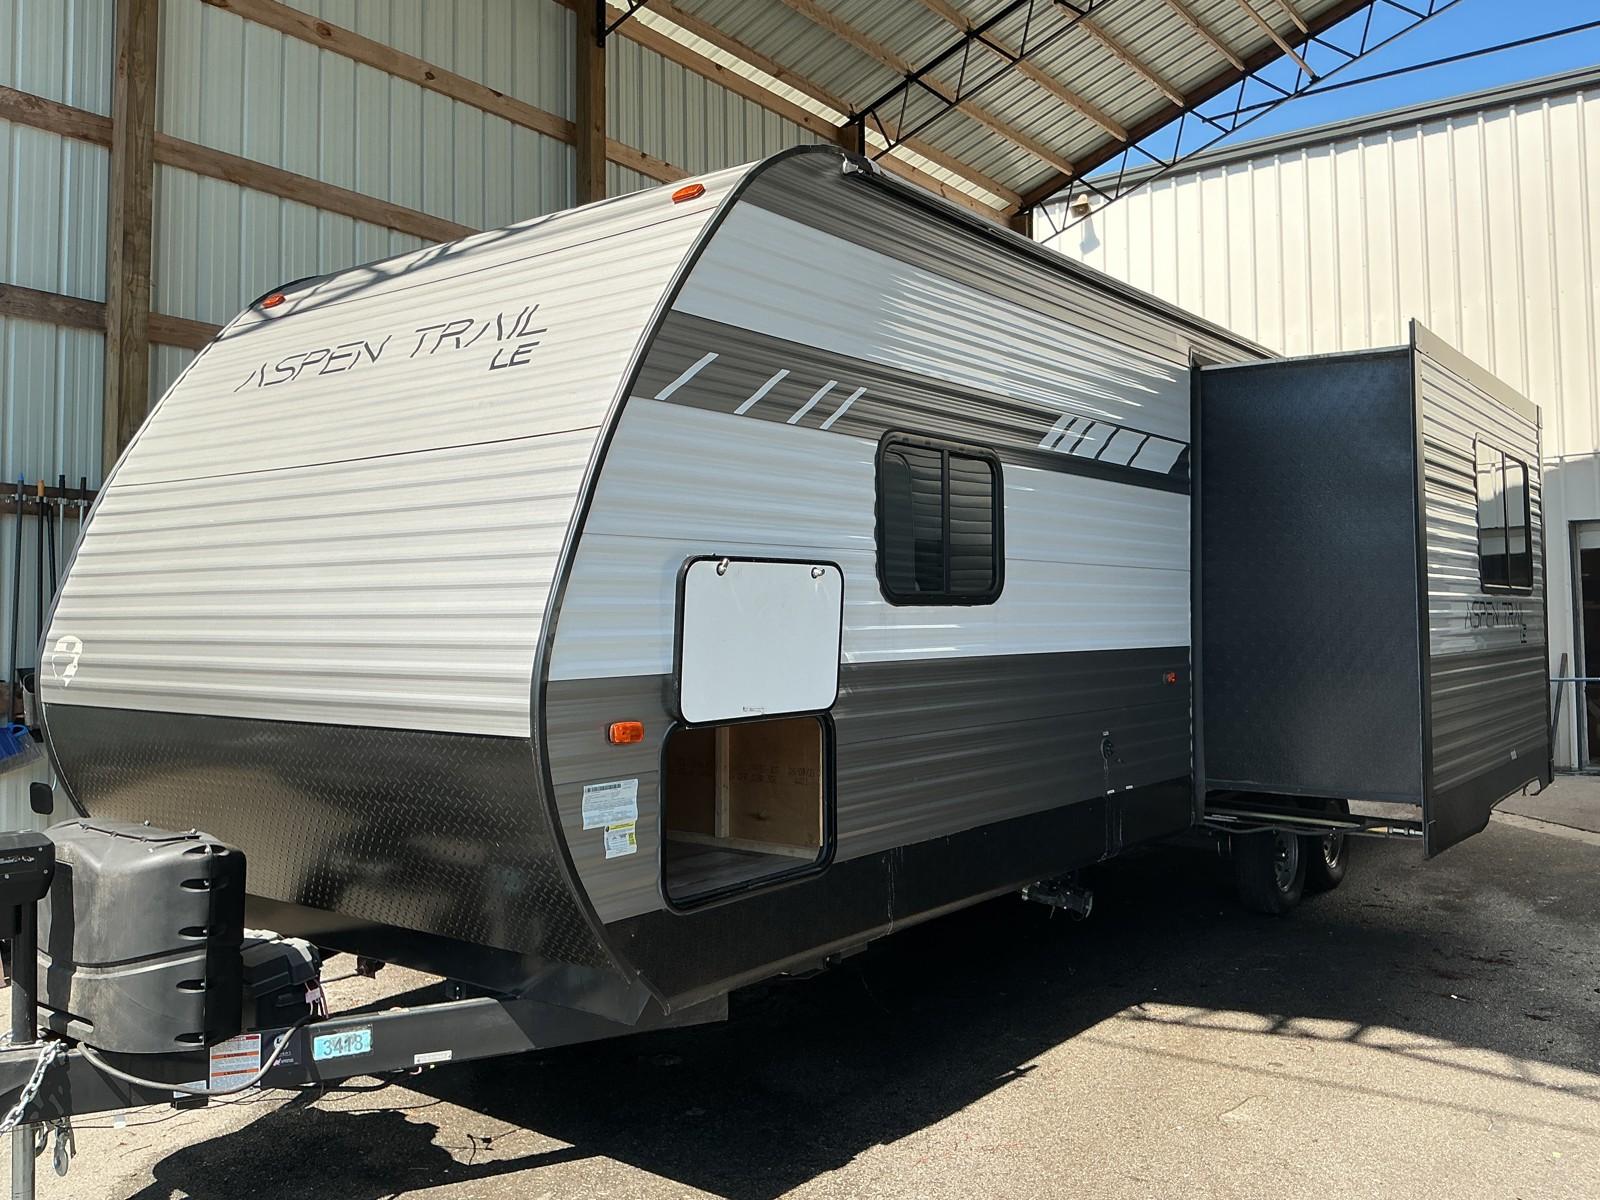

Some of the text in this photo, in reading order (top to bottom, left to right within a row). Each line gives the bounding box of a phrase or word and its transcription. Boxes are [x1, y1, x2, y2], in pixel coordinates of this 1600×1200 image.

[234, 304, 548, 392] ASPEN TRAIL
[488, 341, 540, 371] LE
[1465, 600, 1499, 629] ASPEN
